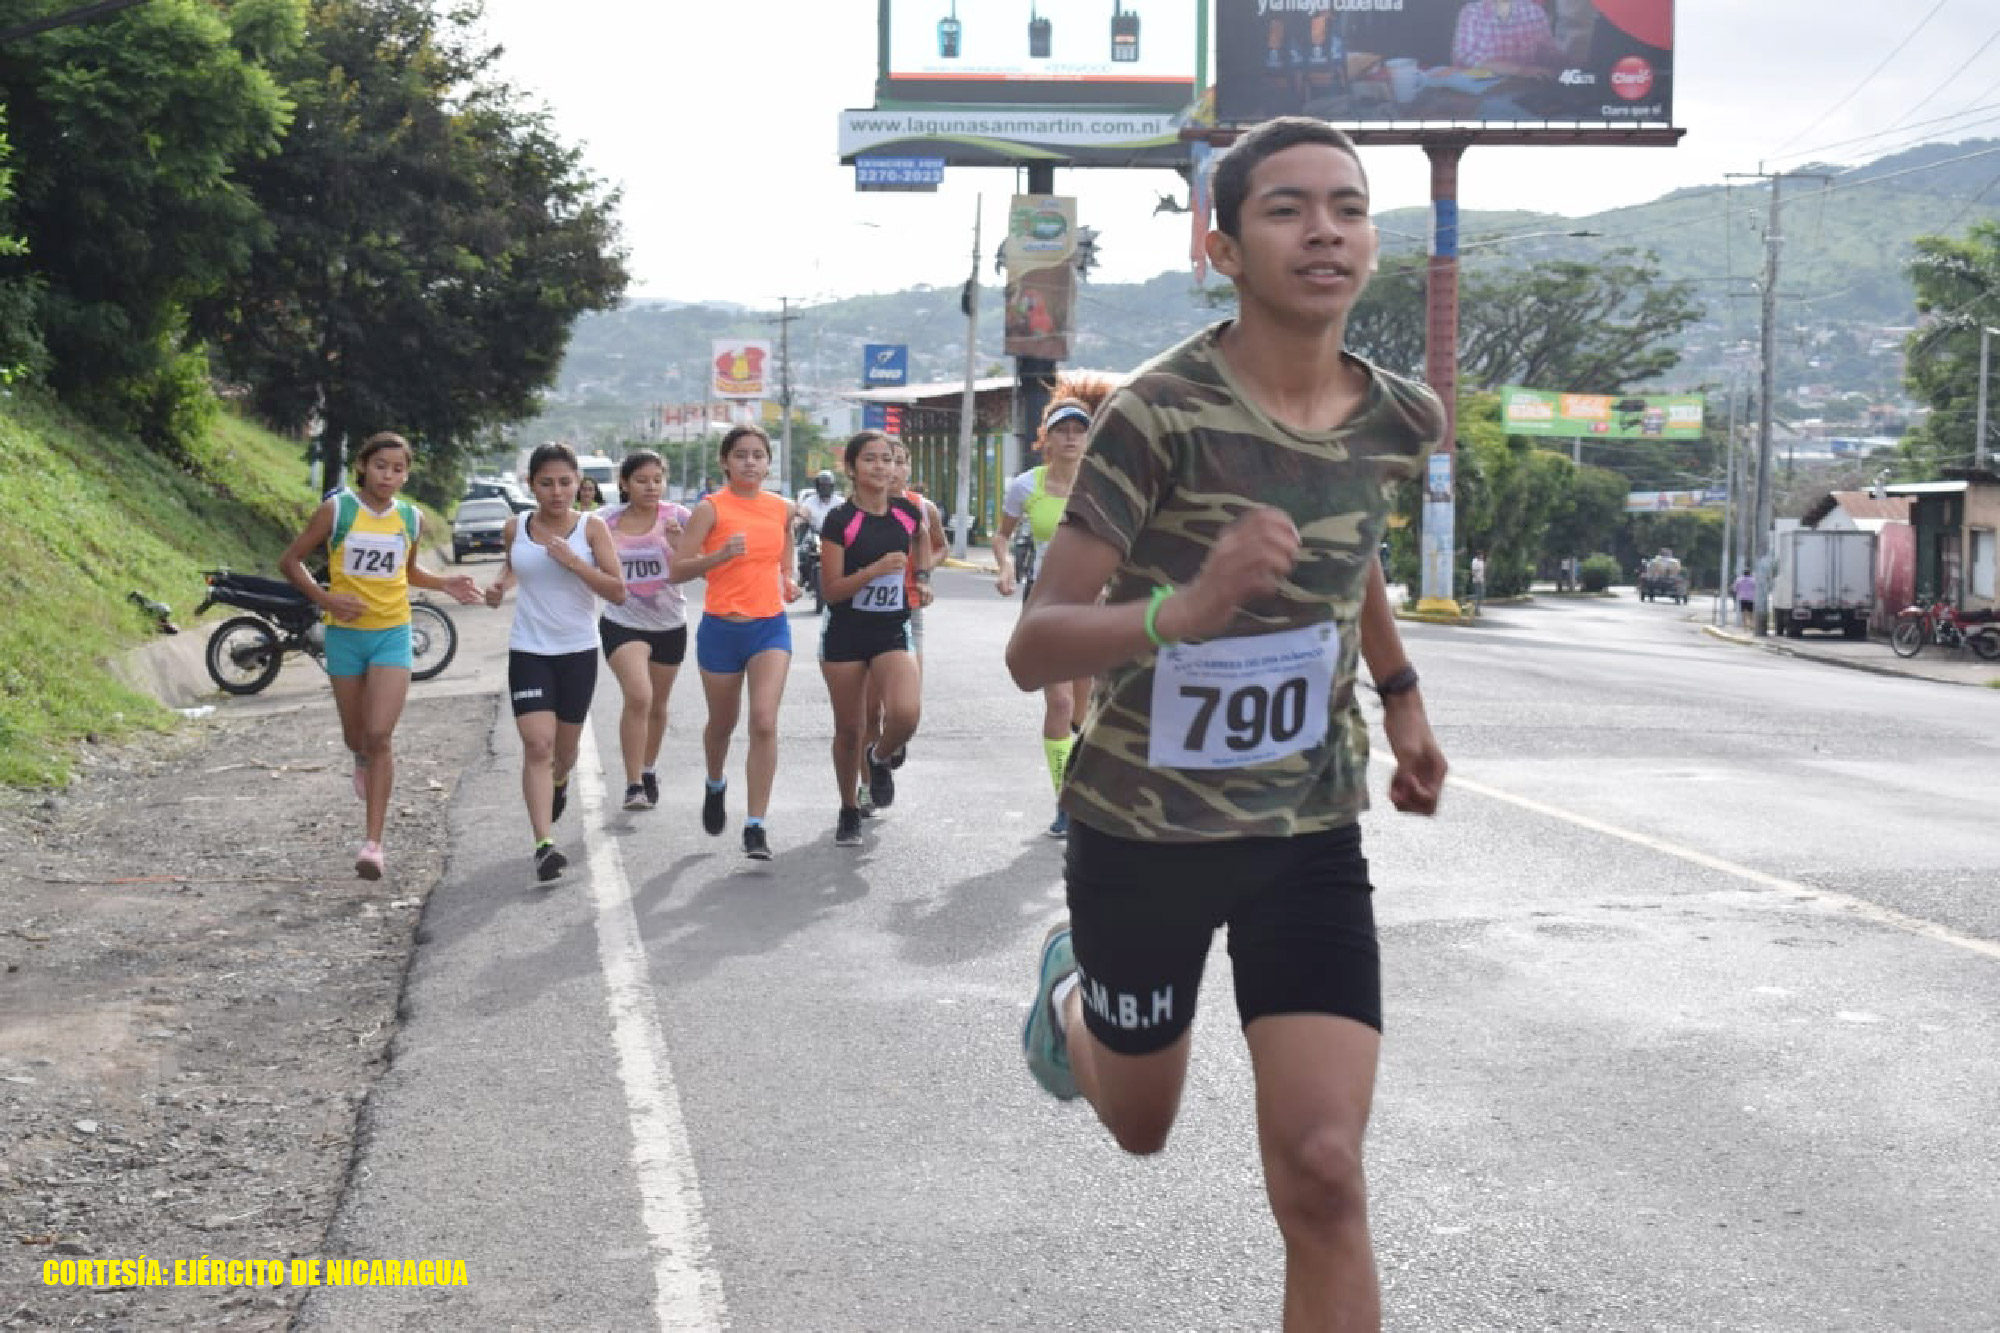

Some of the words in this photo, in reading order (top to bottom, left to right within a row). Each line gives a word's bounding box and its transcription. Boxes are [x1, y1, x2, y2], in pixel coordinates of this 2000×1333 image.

[1611, 69, 1650, 84] Claro
[1602, 105, 1629, 116] Claro
[850, 117, 1161, 135] www.lagunasanmartin.com.ni
[352, 547, 395, 574] 724
[860, 586, 899, 606] 792
[1179, 677, 1309, 752] 790
